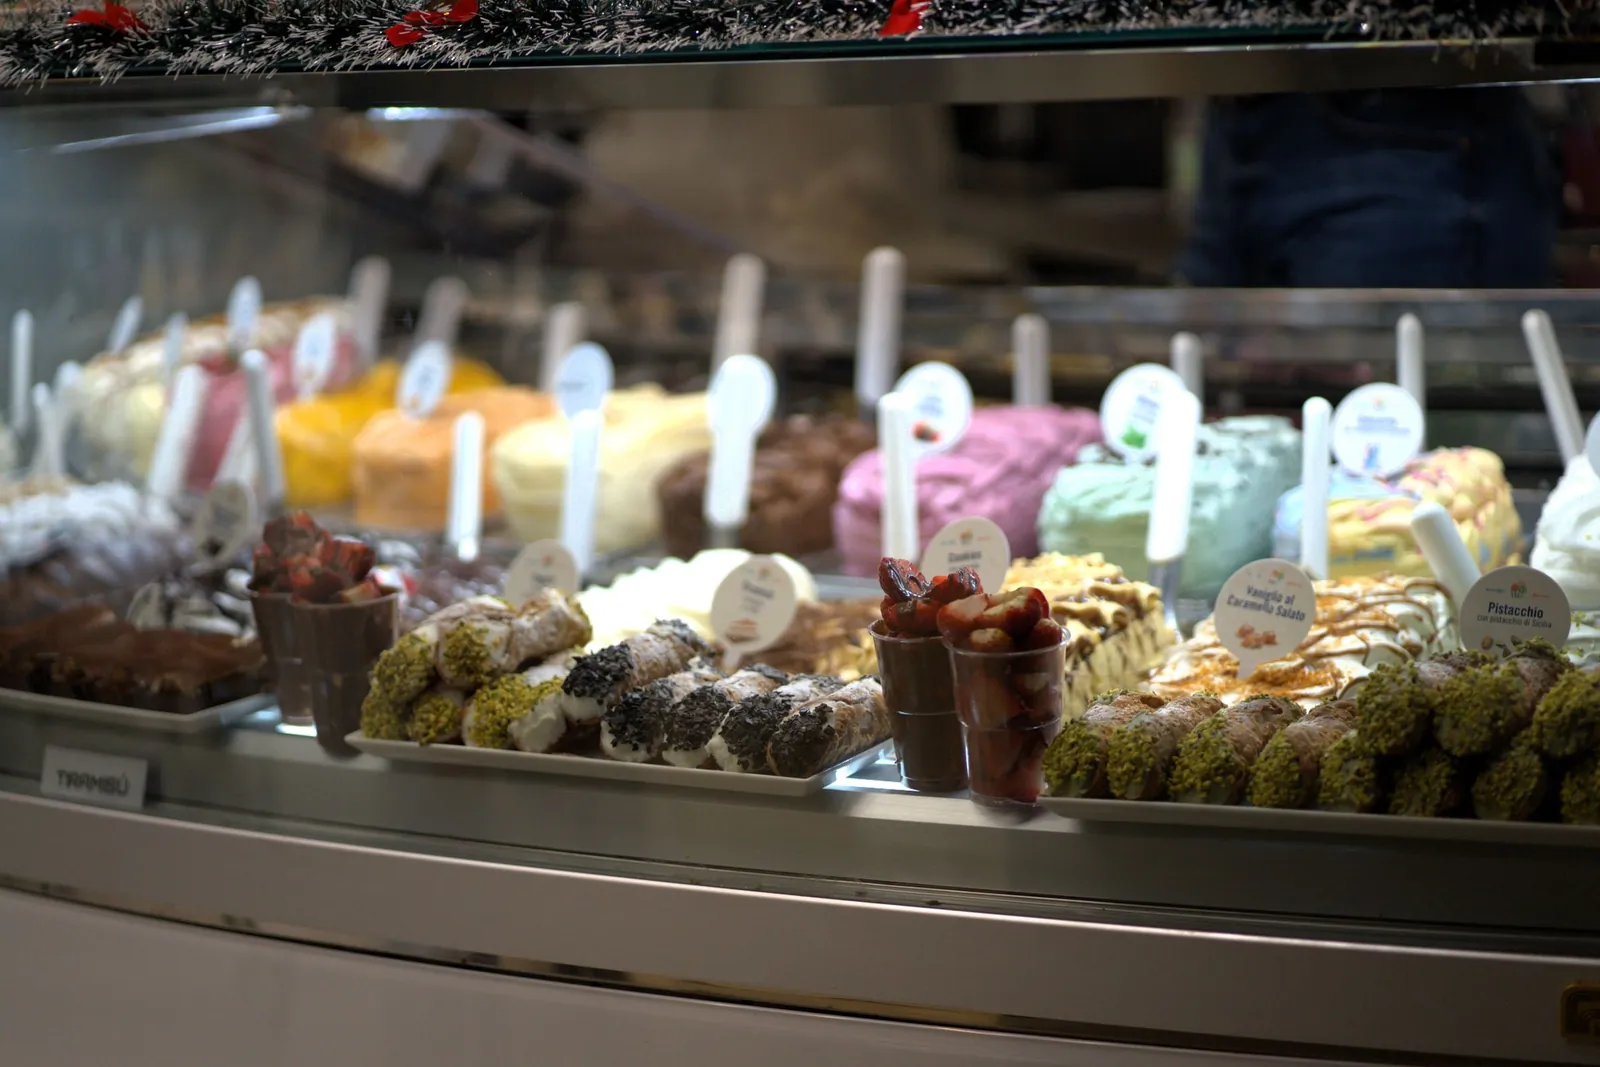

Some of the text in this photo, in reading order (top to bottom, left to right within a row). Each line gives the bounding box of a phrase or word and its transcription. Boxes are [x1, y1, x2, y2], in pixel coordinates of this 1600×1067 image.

[1247, 585, 1295, 605] Vaniglia al
[1227, 594, 1305, 621] Caramello Salato
[1488, 601, 1544, 619] Pistacchio
[1477, 614, 1489, 622] con
[1531, 620, 1552, 629] Sicilia
